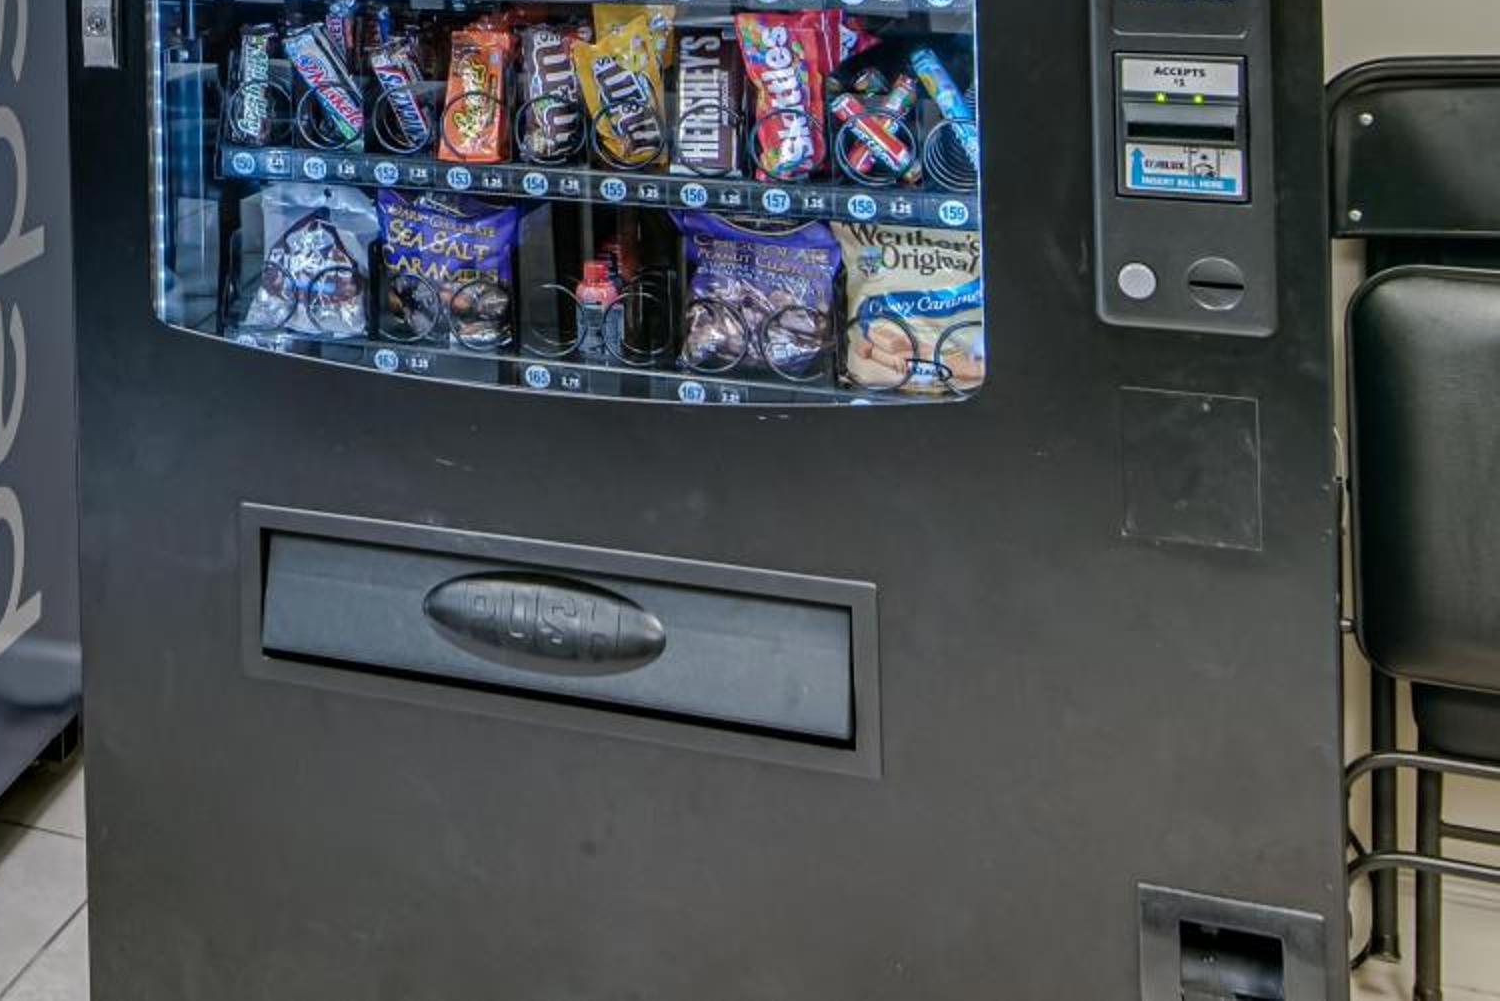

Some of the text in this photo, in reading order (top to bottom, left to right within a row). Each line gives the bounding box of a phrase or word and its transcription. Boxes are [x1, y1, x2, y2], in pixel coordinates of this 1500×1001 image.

[1154, 66, 1206, 77] ACCEPTS
[679, 35, 721, 159] HERSHEY'S
[761, 23, 815, 159] Skittles
[376, 167, 398, 180] 152
[449, 172, 469, 184] 153
[524, 178, 545, 190] 154
[603, 183, 625, 196] 155
[683, 189, 705, 201] 156
[765, 194, 788, 207] 157
[850, 201, 875, 214] 158
[942, 206, 965, 220] 159
[389, 218, 490, 261] SEA SALT
[843, 222, 980, 256] Werther's
[382, 244, 498, 284] CARAMELS
[881, 245, 980, 276] Original
[868, 299, 915, 317] Chewy
[527, 370, 549, 383] 165
[681, 386, 702, 399] 167
